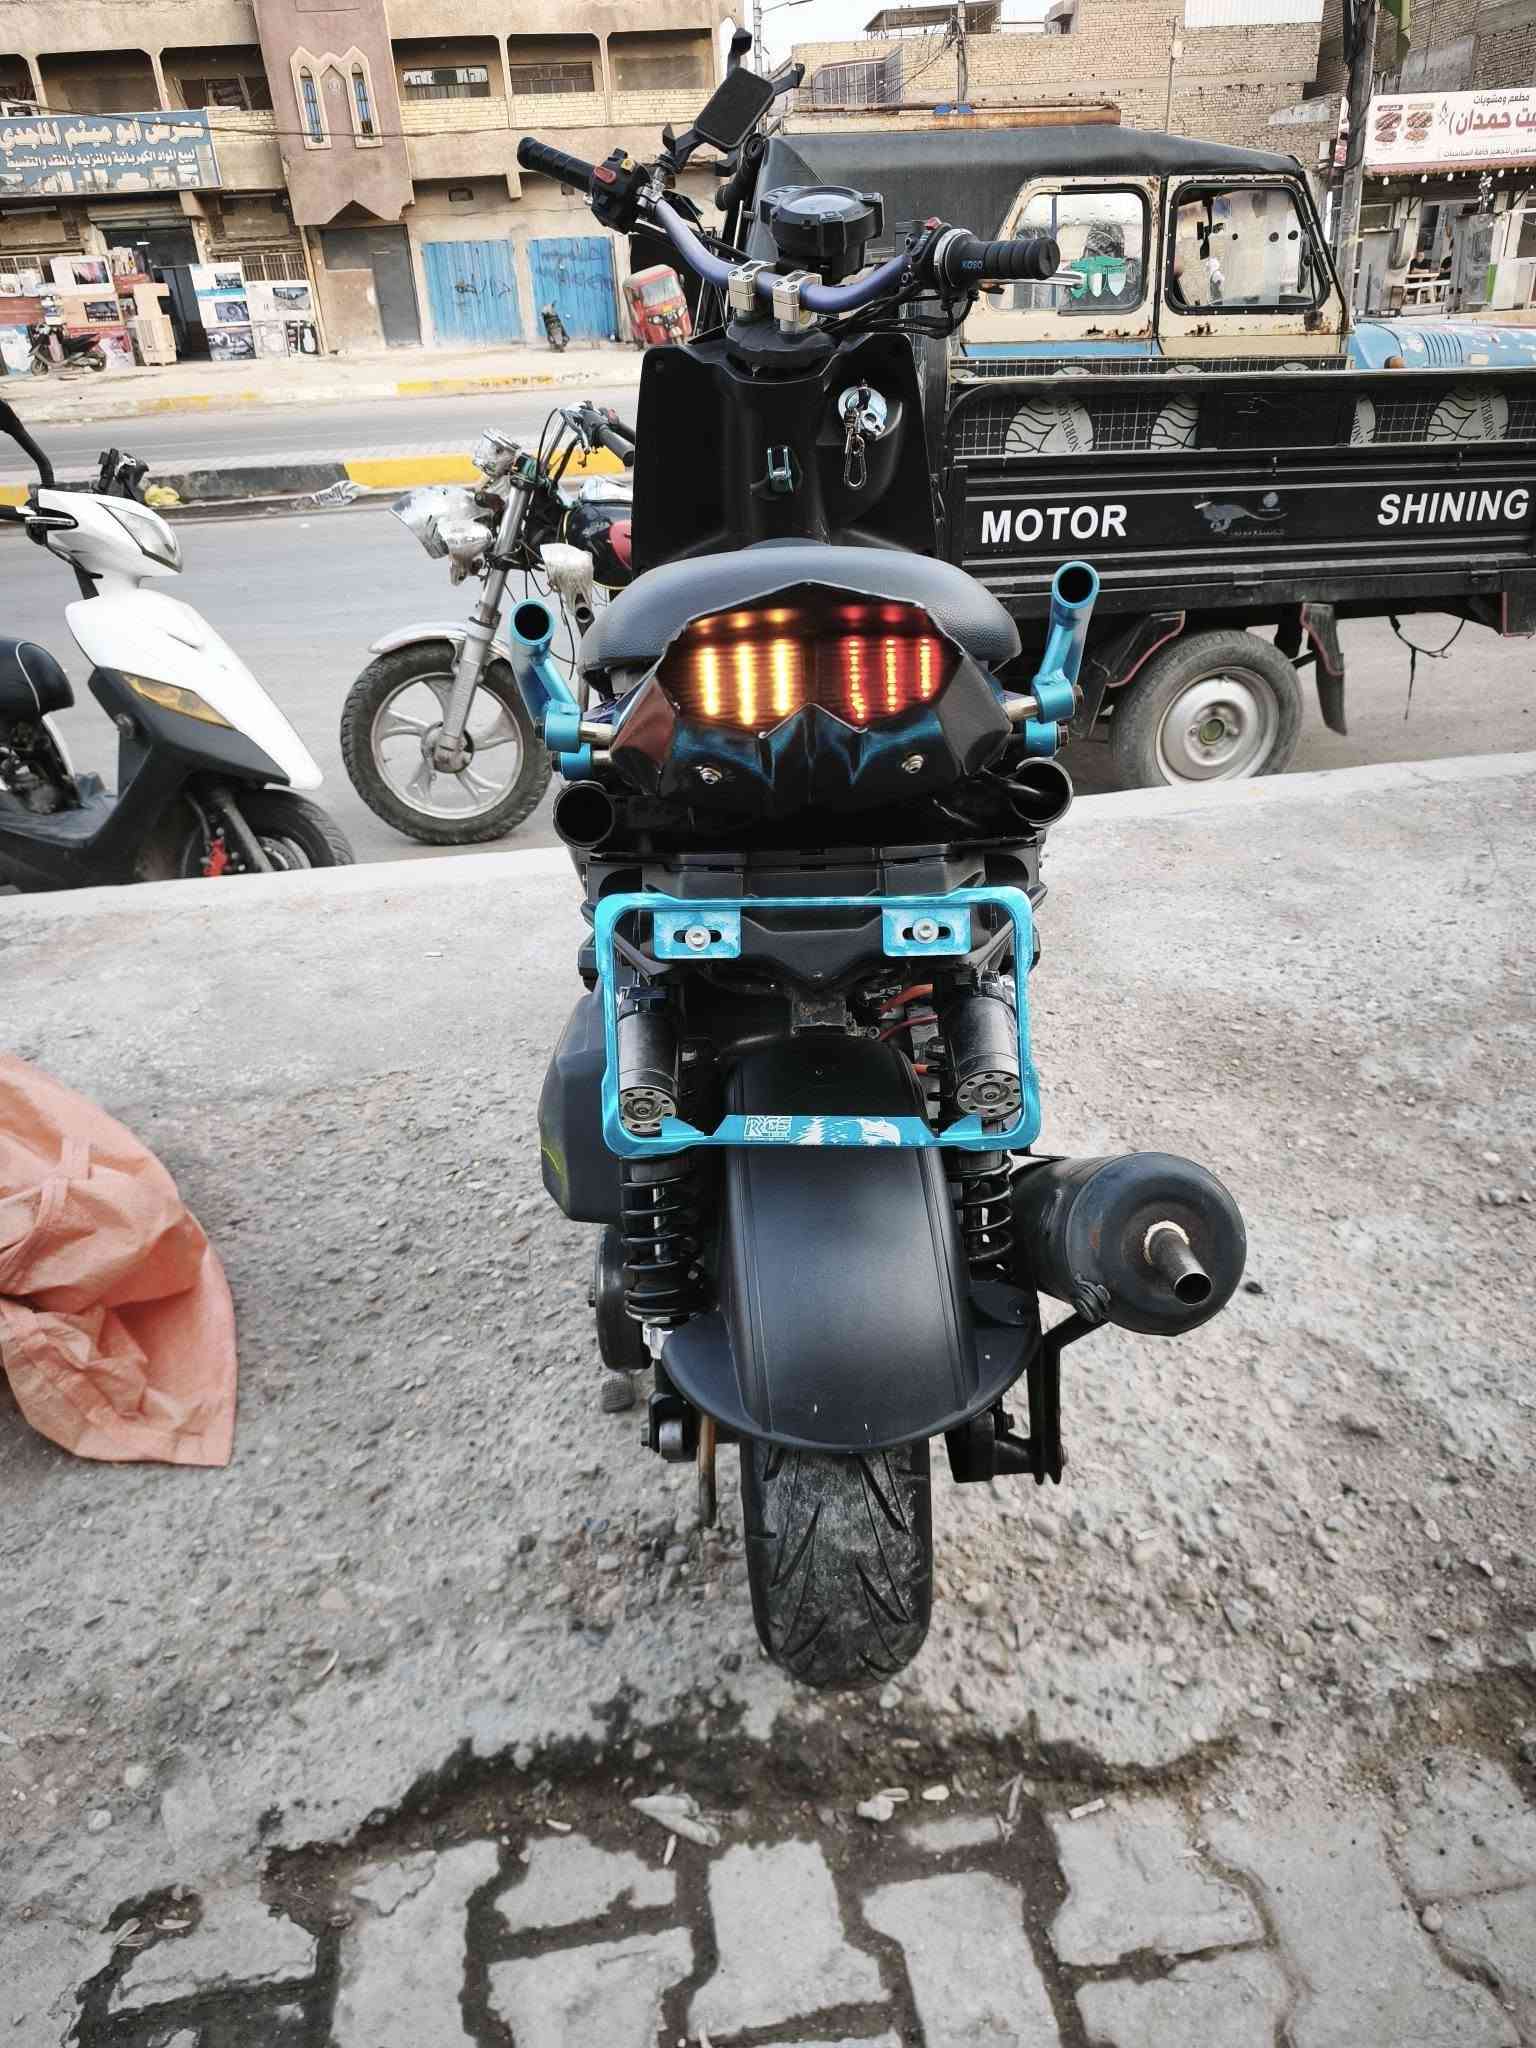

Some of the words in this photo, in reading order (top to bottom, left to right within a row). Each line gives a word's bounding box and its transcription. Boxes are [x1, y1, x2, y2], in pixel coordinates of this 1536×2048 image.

[1473, 95, 1507, 107] ومشويات
[1508, 93, 1530, 104] مطعم
[145, 117, 205, 145] معرض
[47, 153, 76, 169] بالنقد
[77, 152, 112, 168] والمنزلية
[112, 150, 157, 166] الكهربائية
[158, 149, 177, 163] المواد
[178, 148, 195, 164] لبيع
[1376, 489, 1530, 526] SHINING
[980, 504, 1128, 544] MOTOR
